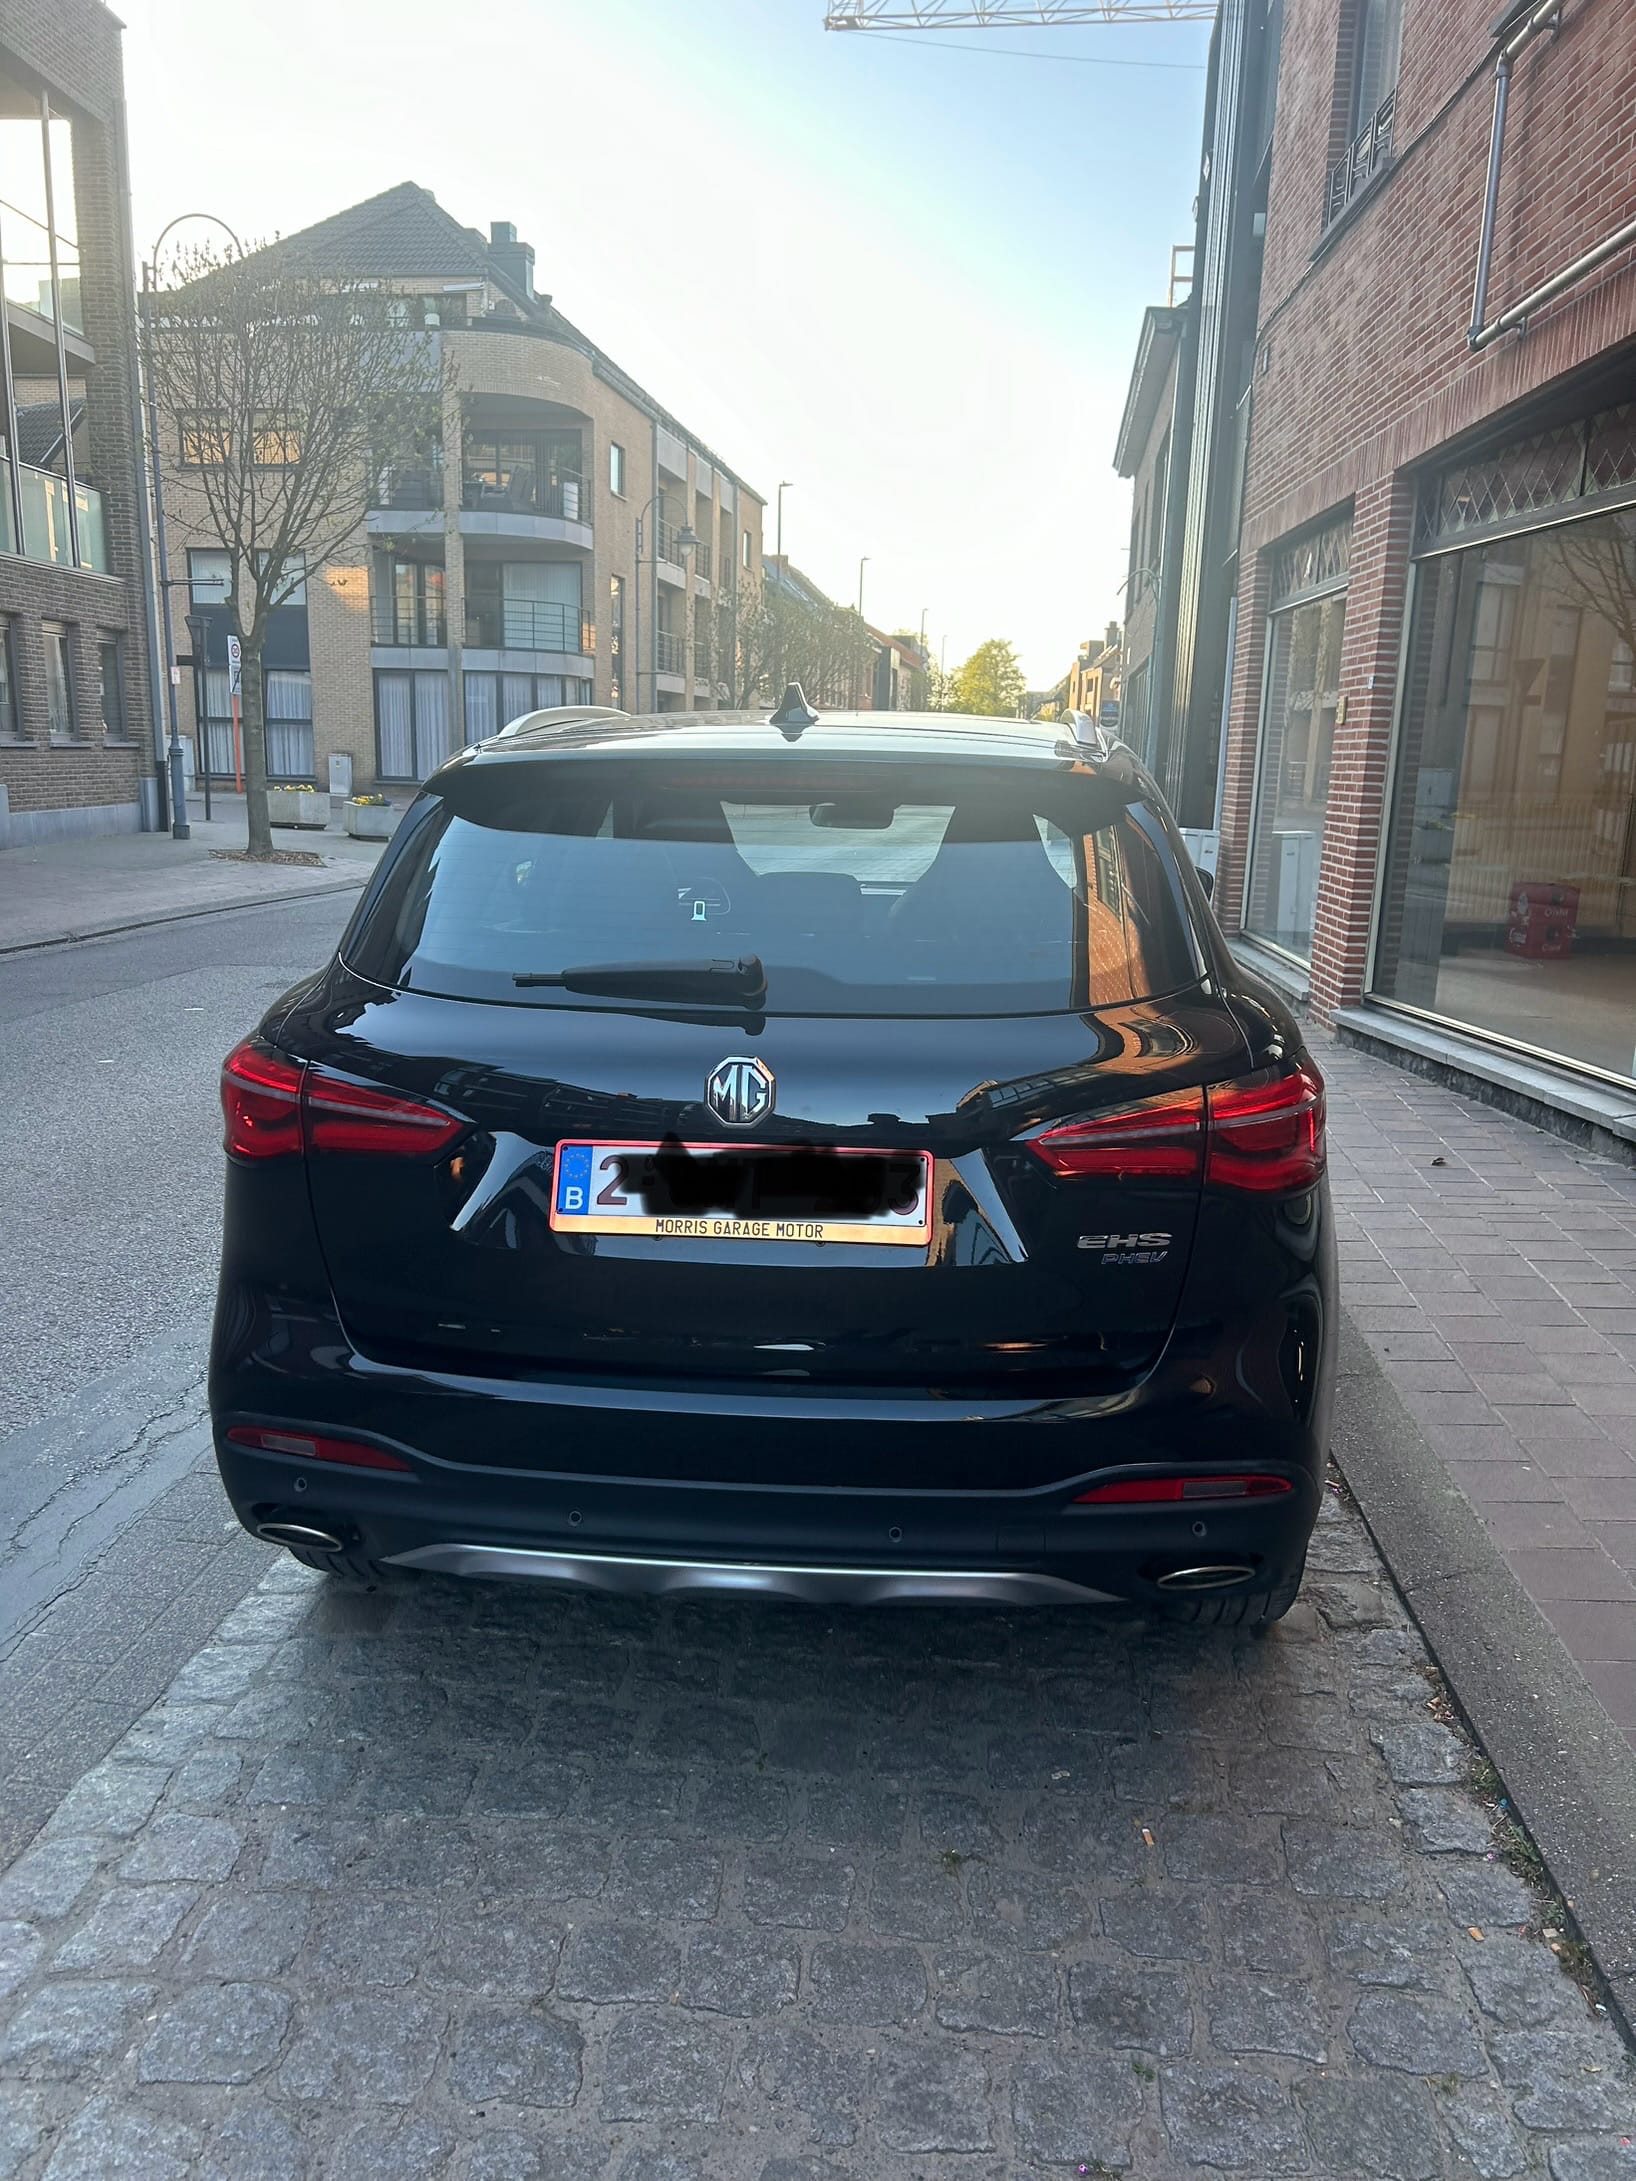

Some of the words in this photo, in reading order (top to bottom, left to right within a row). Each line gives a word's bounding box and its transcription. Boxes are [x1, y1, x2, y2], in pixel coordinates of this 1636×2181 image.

[713, 1065, 767, 1121] MG
[565, 1186, 584, 1210] B
[655, 1219, 708, 1233] MORRIS
[713, 1221, 770, 1237] GARAGE
[776, 1223, 823, 1239] MOTOR
[1077, 1232, 1172, 1249] EHS
[1101, 1250, 1168, 1264] PHEV
